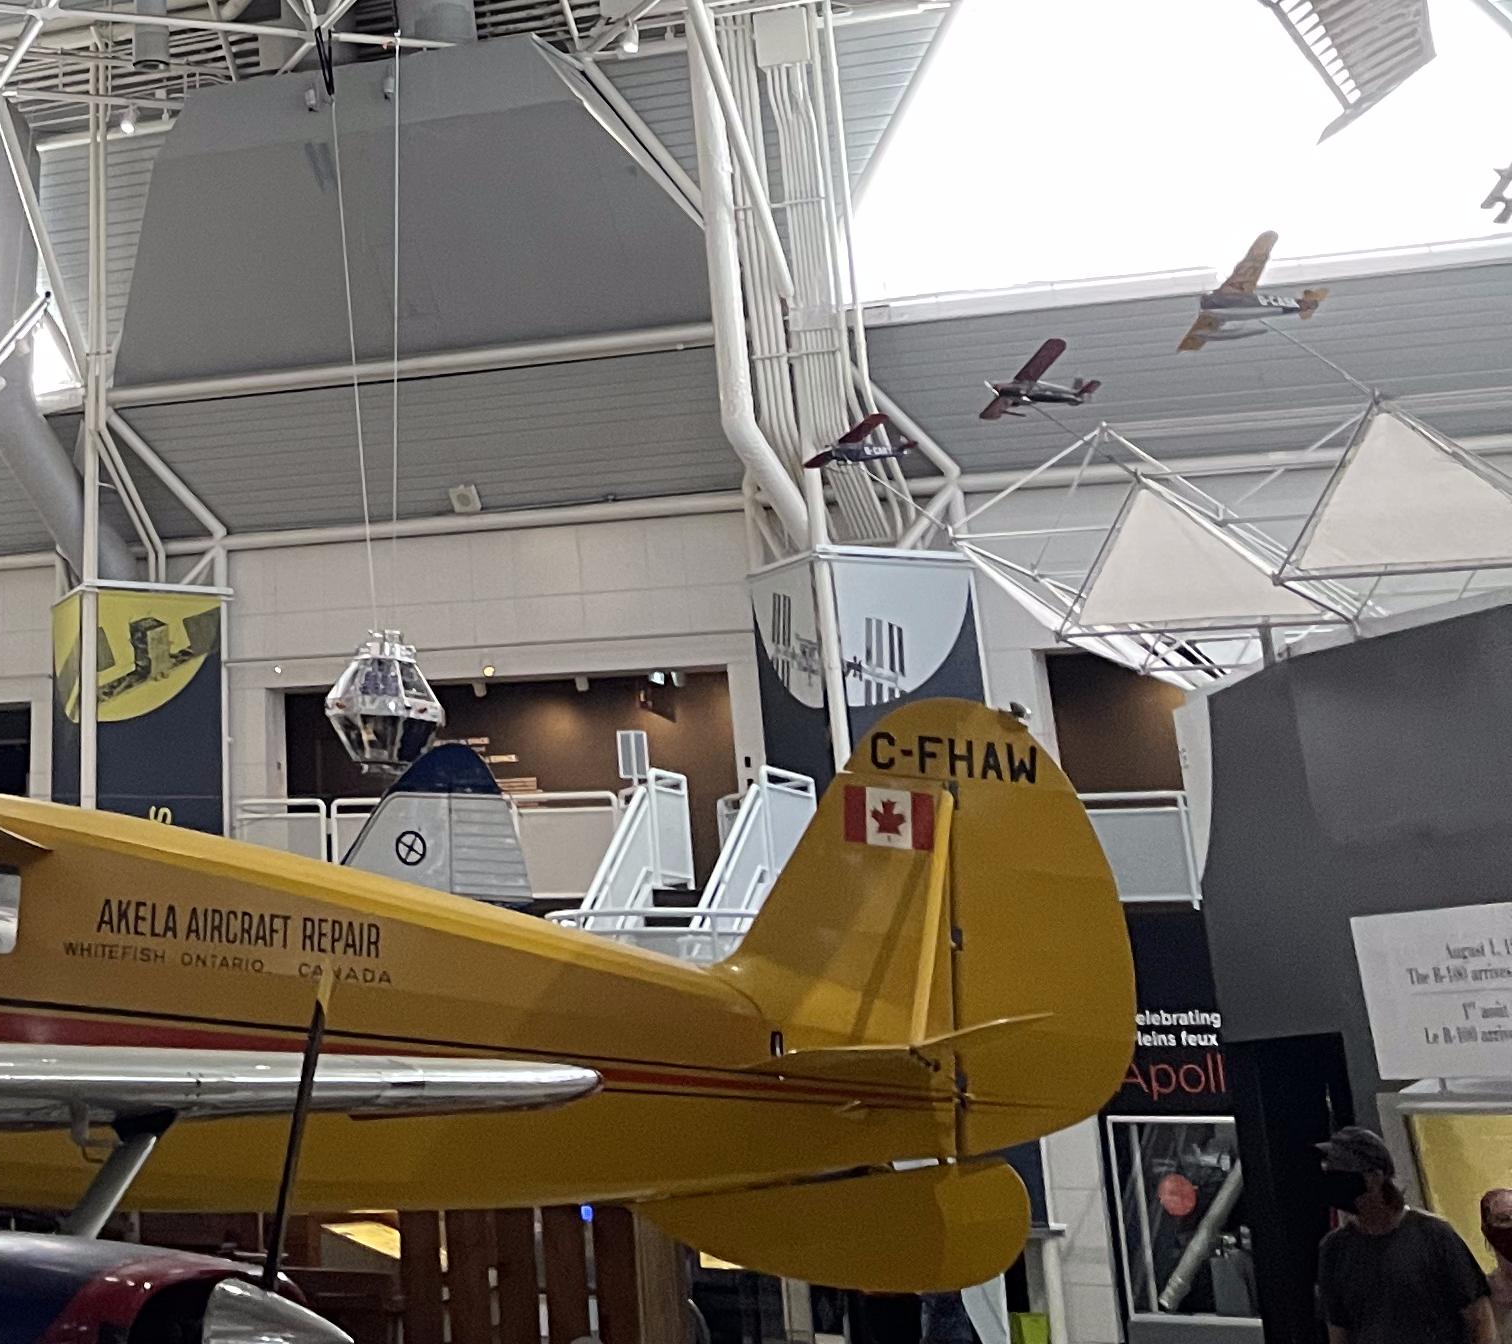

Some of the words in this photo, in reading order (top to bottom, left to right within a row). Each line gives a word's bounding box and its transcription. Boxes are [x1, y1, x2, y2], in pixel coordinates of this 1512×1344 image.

[871, 731, 1037, 784] C-FHAW
[97, 899, 178, 940] AKELA
[186, 907, 291, 949] AIRCRAFT
[302, 917, 381, 959] REPAIR
[63, 942, 166, 964] WHITEFISH
[1406, 967, 1429, 985] The
[1135, 1009, 1221, 1028] elebrating
[1137, 1031, 1176, 1046] leins
[1180, 1030, 1218, 1046] feux
